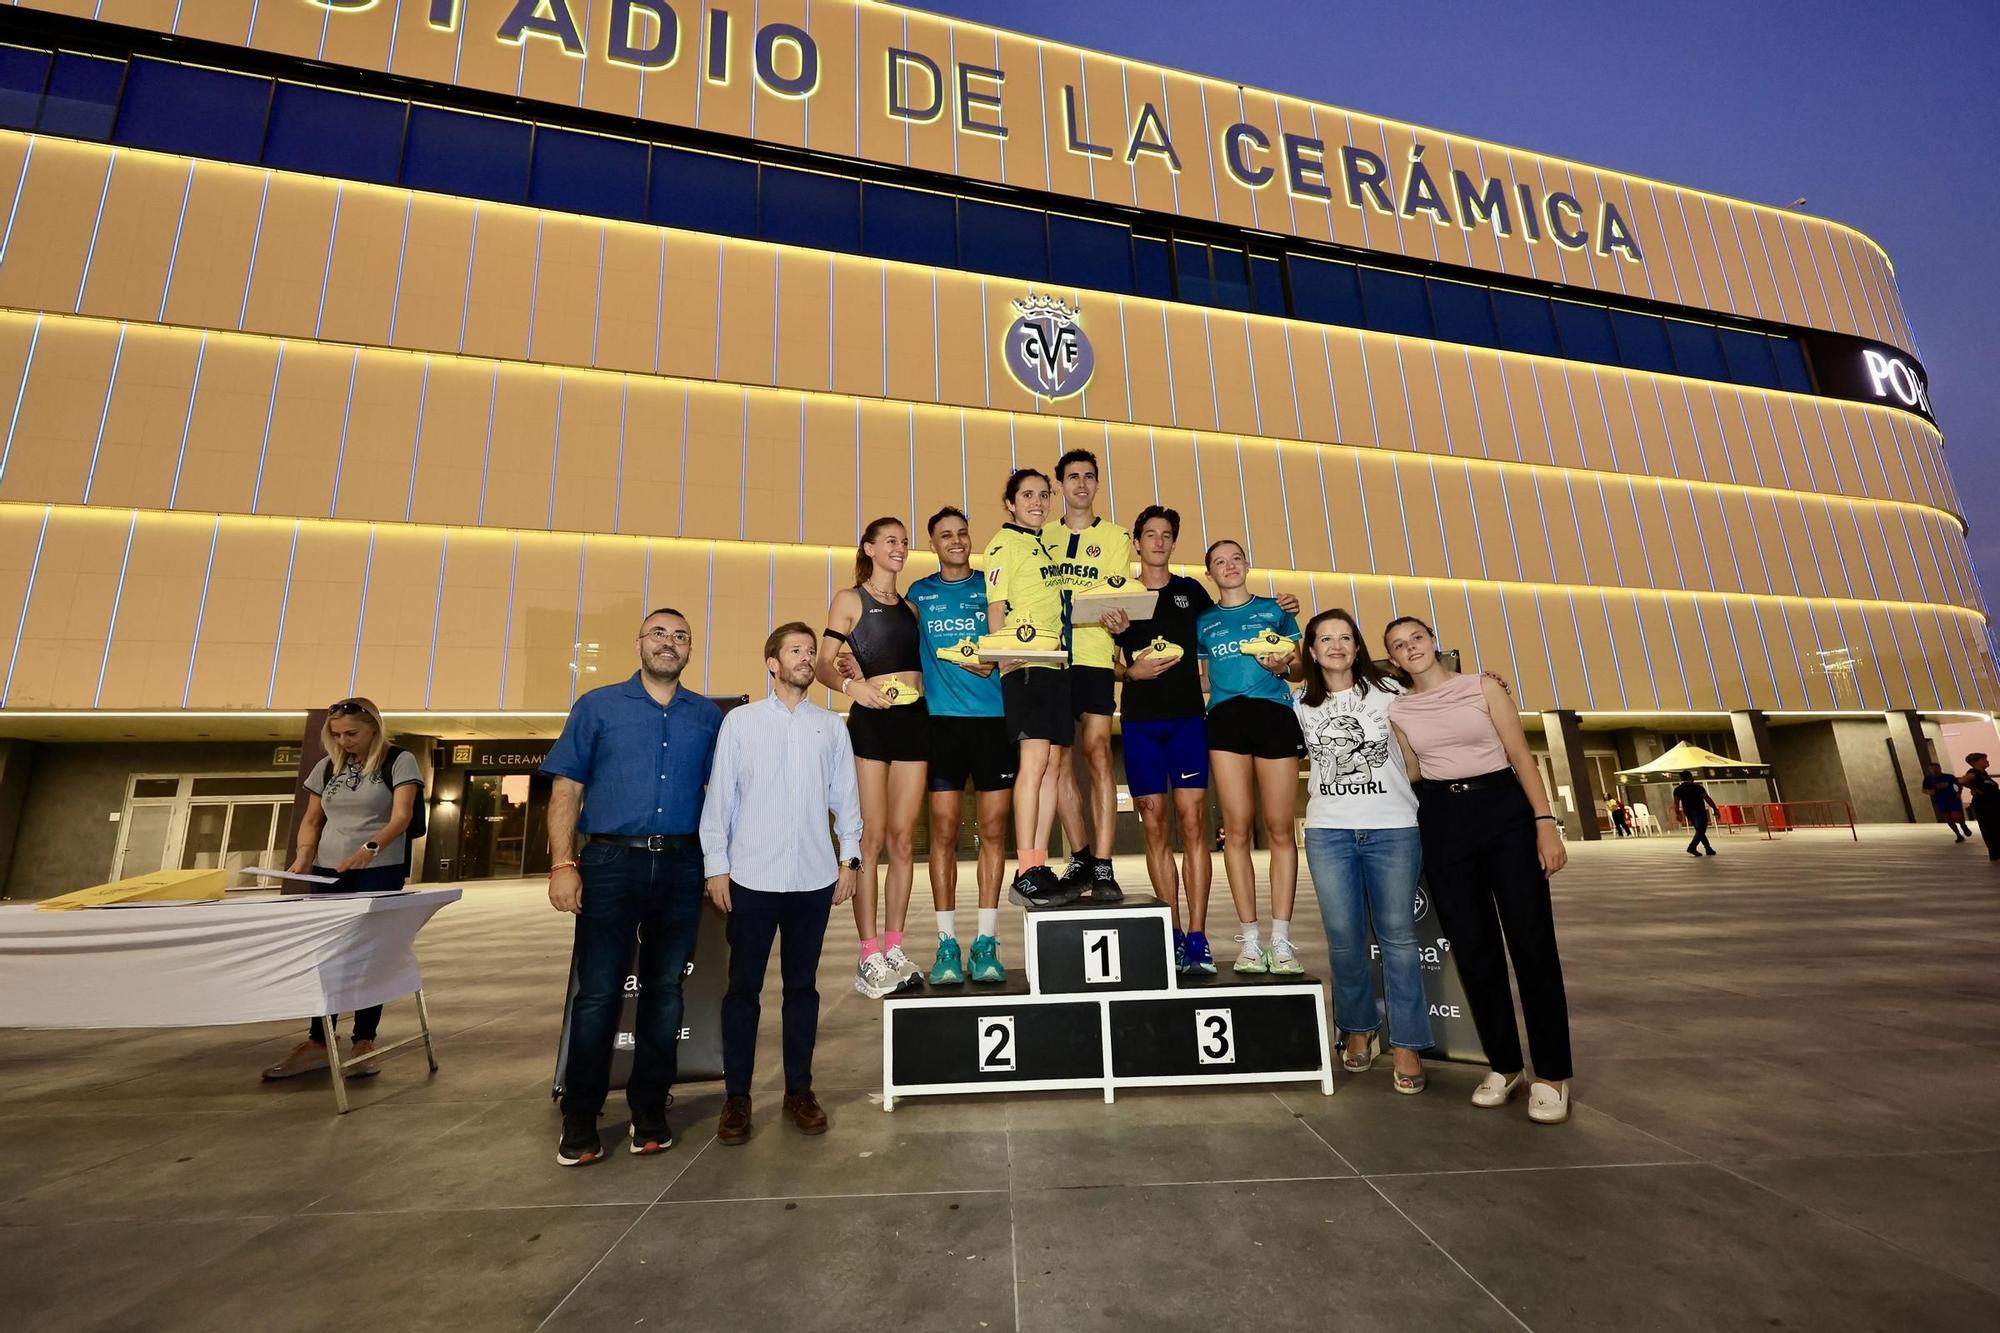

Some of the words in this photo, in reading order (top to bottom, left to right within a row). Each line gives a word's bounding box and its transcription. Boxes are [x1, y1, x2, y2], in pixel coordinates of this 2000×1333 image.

[887, 46, 1009, 140] DE
[1063, 84, 1182, 174] LA
[1223, 121, 1642, 263] CERÁMICA
[927, 617, 976, 633] Facsa
[277, 754, 289, 762] 21
[456, 752, 469, 761] 22
[481, 755, 495, 765] EL
[1091, 936, 1109, 977] 1
[984, 1023, 1011, 1067] 2
[1202, 1015, 1229, 1058] 3
